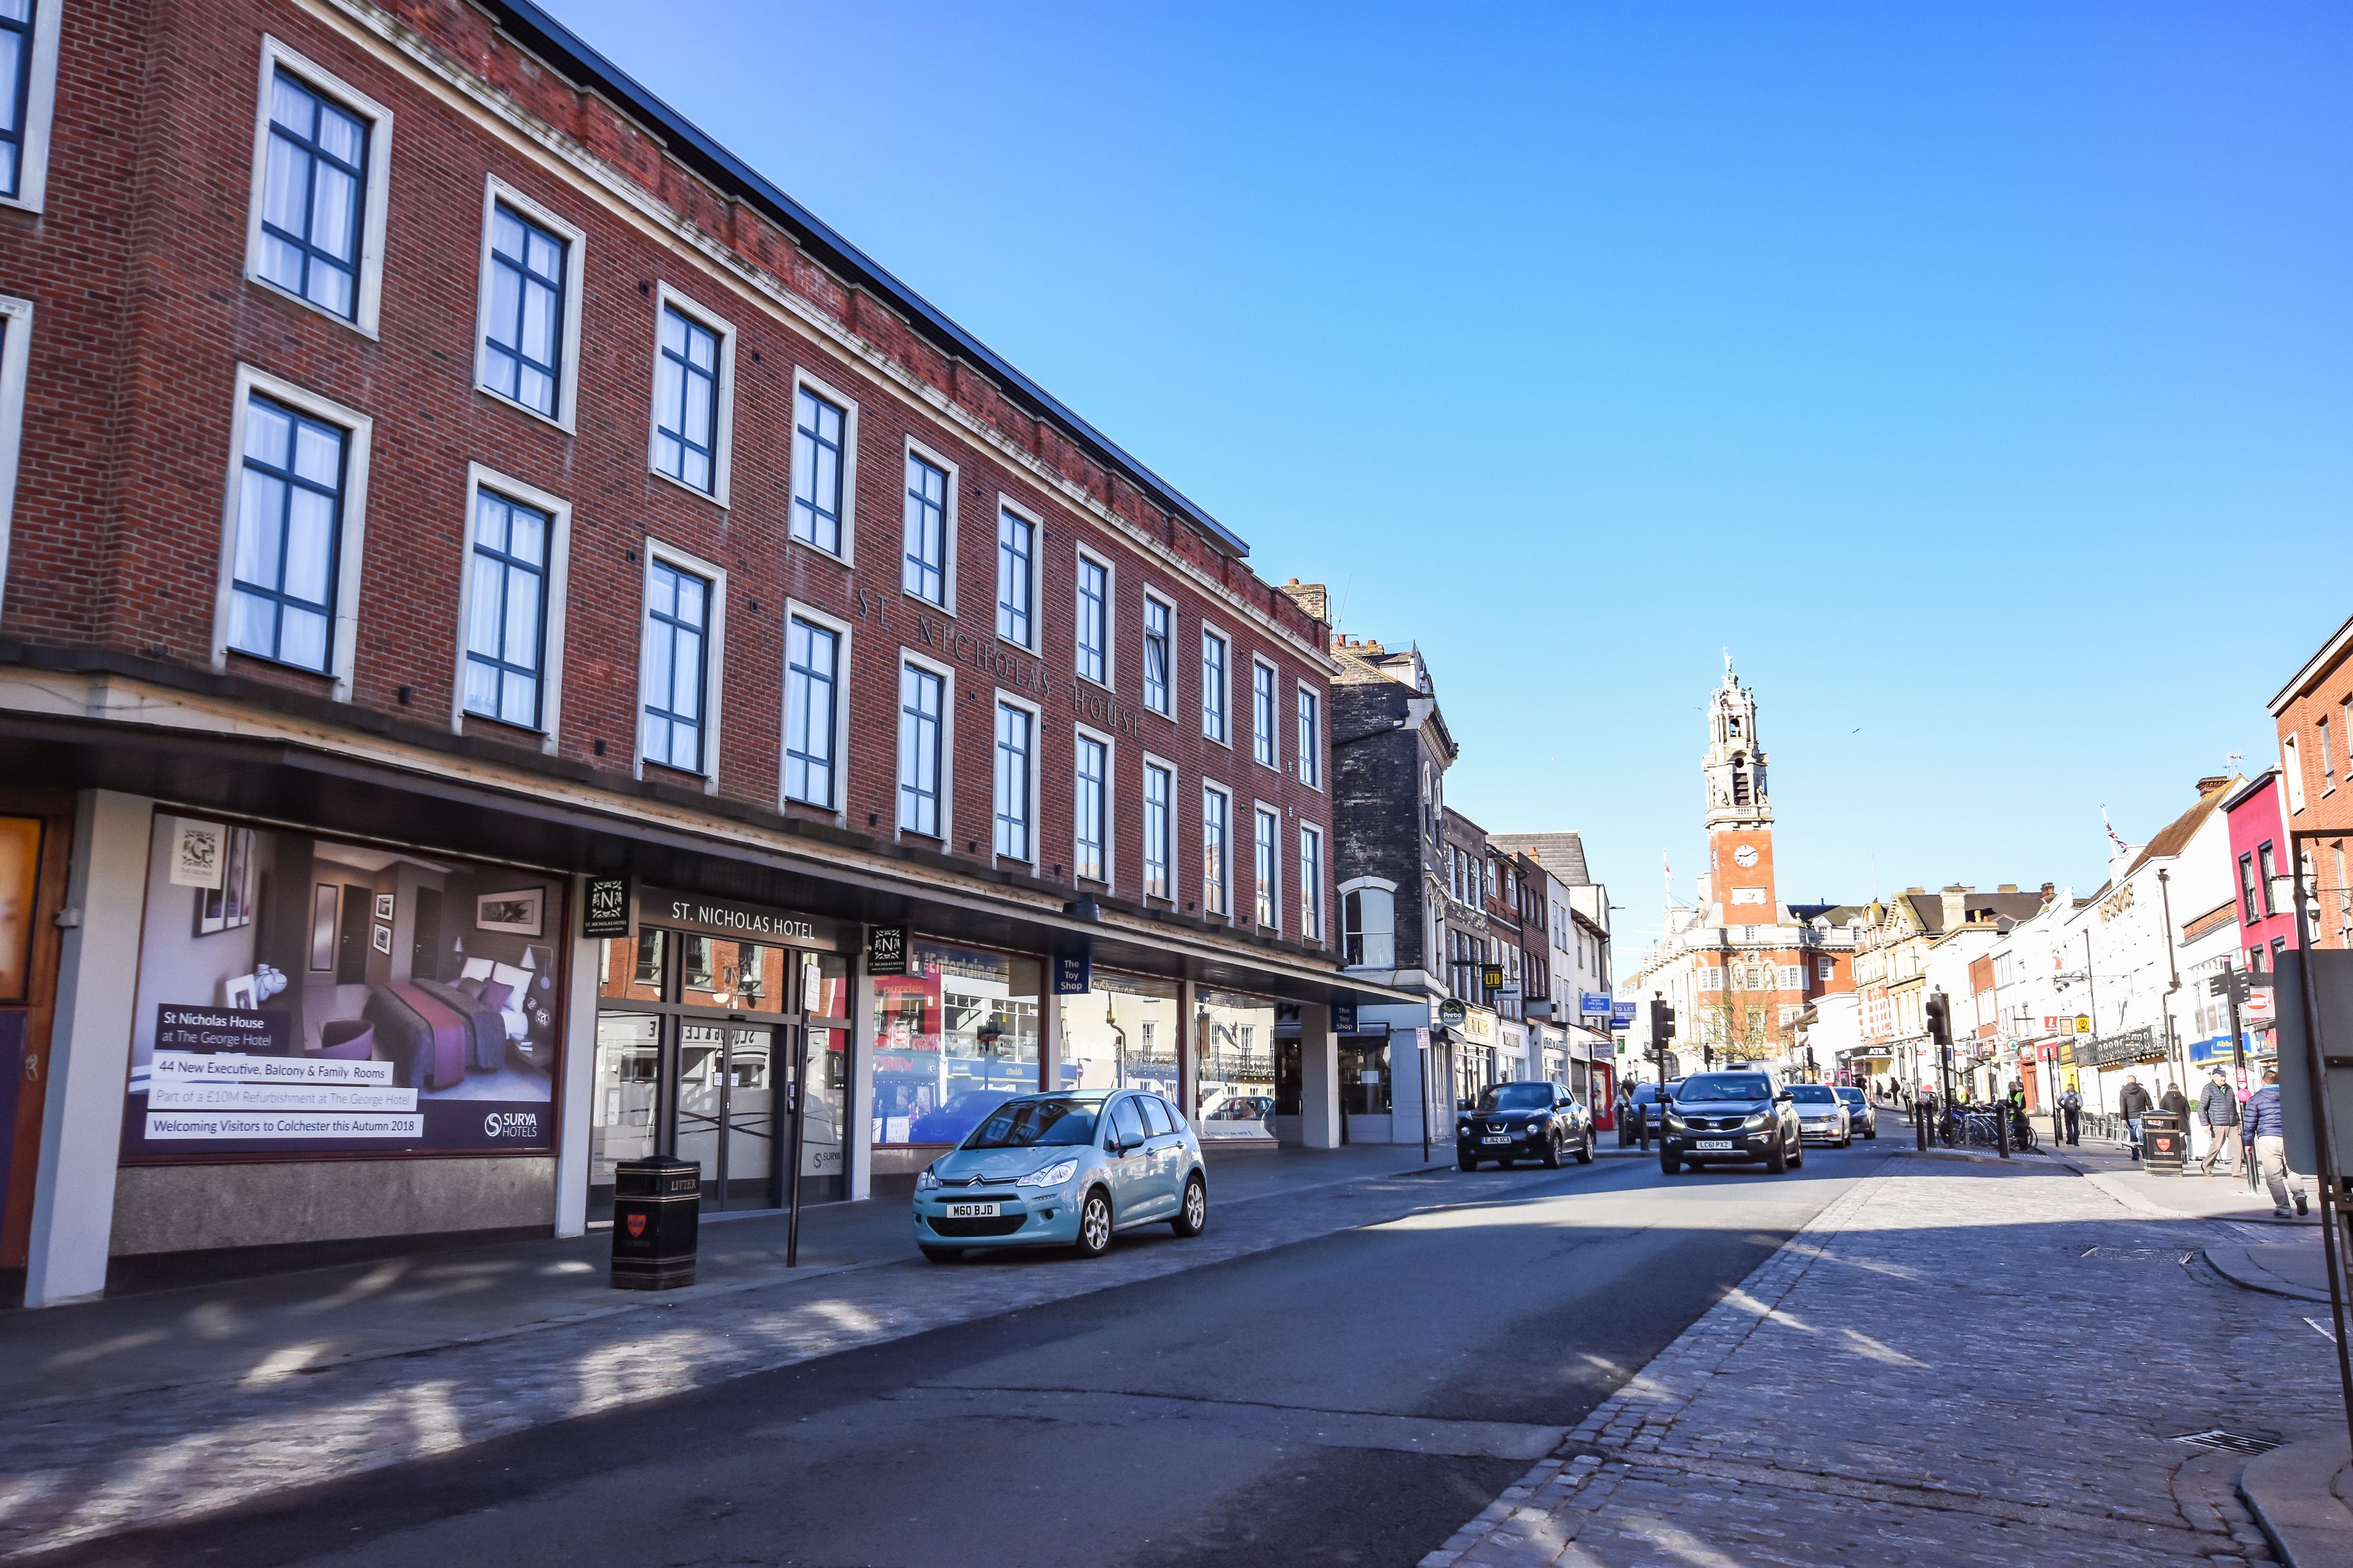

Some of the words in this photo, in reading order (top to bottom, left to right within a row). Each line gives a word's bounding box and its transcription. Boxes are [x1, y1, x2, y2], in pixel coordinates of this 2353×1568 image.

[919, 615, 1051, 697] NICHOLAS
[1074, 687, 1140, 739] HOUSE
[601, 890, 613, 908] N
[672, 901, 693, 921] ST.
[699, 906, 769, 933] NICHOLAS
[774, 918, 815, 939] HOTEL
[882, 937, 893, 952] N
[930, 952, 998, 982] Entertainer
[1064, 960, 1080, 968] The
[1065, 971, 1078, 980] Toy
[1485, 973, 1500, 985] LTB
[884, 982, 925, 994] puzzles
[1061, 982, 1082, 991] Shop
[163, 1012, 176, 1023] St
[179, 1013, 227, 1026] Nicholas
[230, 1015, 264, 1029] House
[162, 1032, 173, 1042] at
[176, 1030, 197, 1043] The
[200, 1031, 240, 1047] George
[243, 1033, 271, 1046] Hotel
[159, 1061, 175, 1072] 44
[178, 1061, 204, 1074] New
[208, 1062, 262, 1075] Executive,
[265, 1064, 305, 1078] Balcony
[308, 1066, 314, 1076] &
[319, 1066, 349, 1080] Family
[354, 1067, 385, 1078] Rooms
[156, 1089, 179, 1102] Part
[183, 1090, 195, 1102] of
[198, 1094, 203, 1102] a
[207, 1091, 239, 1102] £10M
[243, 1091, 315, 1104] Refurbishment
[319, 1094, 327, 1104] at
[330, 1093, 347, 1104] The
[350, 1093, 383, 1107] George
[386, 1094, 410, 1105] Hotel
[503, 1113, 537, 1126] SURYA
[154, 1120, 218, 1134] Welcoming
[220, 1120, 260, 1132] Visitors
[263, 1121, 274, 1132] to
[277, 1120, 330, 1132] Colchester
[333, 1120, 349, 1132] this
[352, 1121, 388, 1132] Autumn
[392, 1121, 415, 1132] 2018
[502, 1126, 537, 1137] HOTELS
[823, 1152, 841, 1161] SURYA
[671, 1179, 696, 1191] LITTER
[953, 1205, 971, 1216] M60
[974, 1205, 993, 1215] BJD
